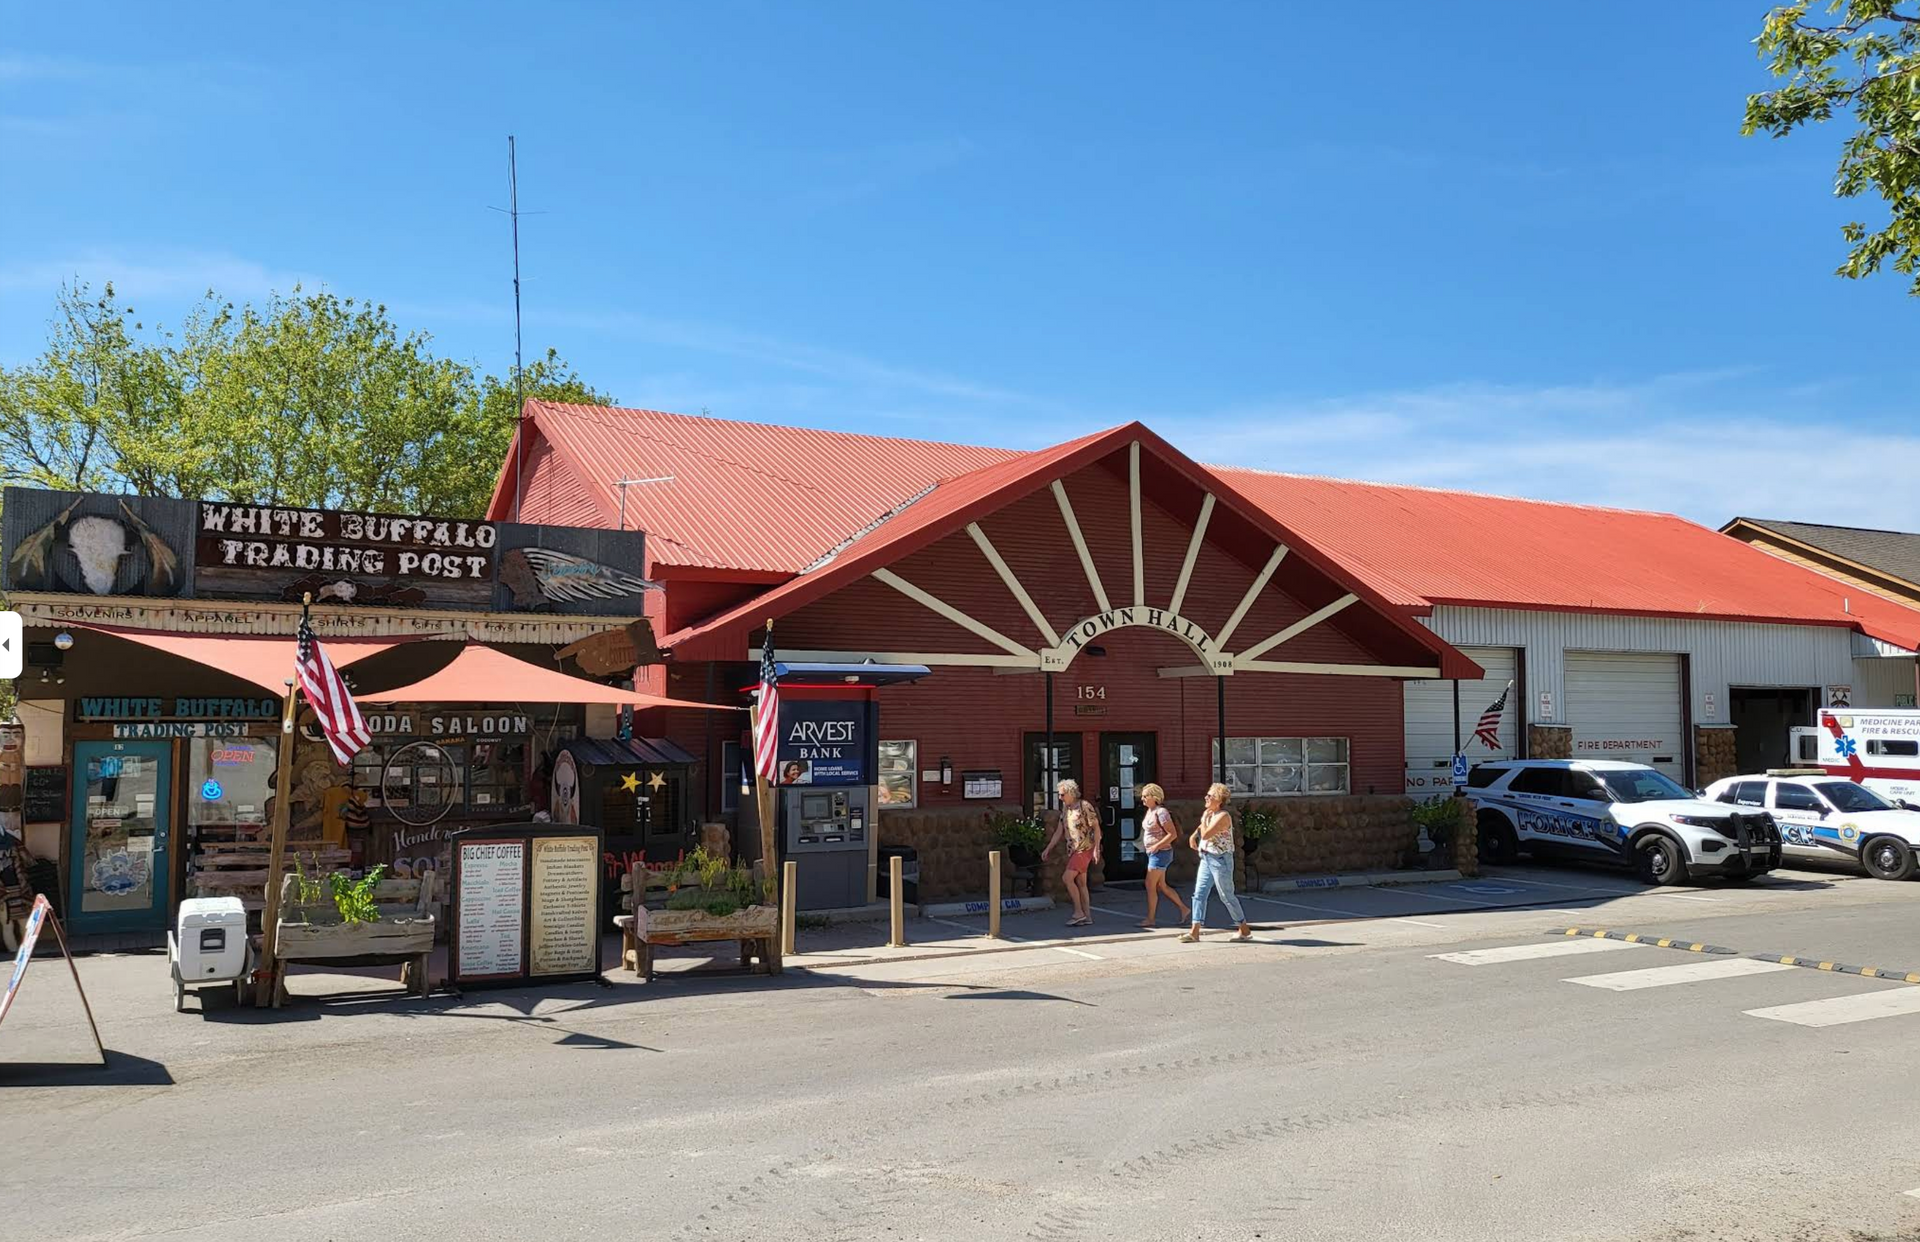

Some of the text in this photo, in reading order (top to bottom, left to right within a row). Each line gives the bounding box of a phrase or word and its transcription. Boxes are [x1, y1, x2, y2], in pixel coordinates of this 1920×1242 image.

[202, 503, 497, 548] WHITE BUFFALO
[218, 539, 487, 579] TRADING POST
[57, 610, 514, 633] SOUVENIRS APPAREL -SHIRTS GIFTS TOYS
[1066, 608, 1210, 653] TOWN HALL
[1213, 661, 1233, 669] 1908
[1076, 686, 1106, 699] 154
[81, 697, 276, 717] WHITE BUFFALO
[368, 715, 528, 734] ODA SALOON
[1859, 718, 1903, 727] MEDICINE
[116, 722, 247, 738] TRADING POST
[788, 721, 855, 748] ARVEST
[1861, 727, 1920, 736] FIRE & RESCU
[435, 737, 466, 747] BANANA
[1578, 740, 1663, 750] FIRE DEPARTMENT
[210, 749, 255, 763] OPEN
[800, 747, 843, 759] BANK
[1406, 777, 1426, 787] NO
[95, 807, 121, 816] OPEN
[1516, 808, 1598, 842] POLICE
[462, 845, 522, 860] BIG CHIEF COFFEE
[965, 900, 1022, 913] COMP CAR
